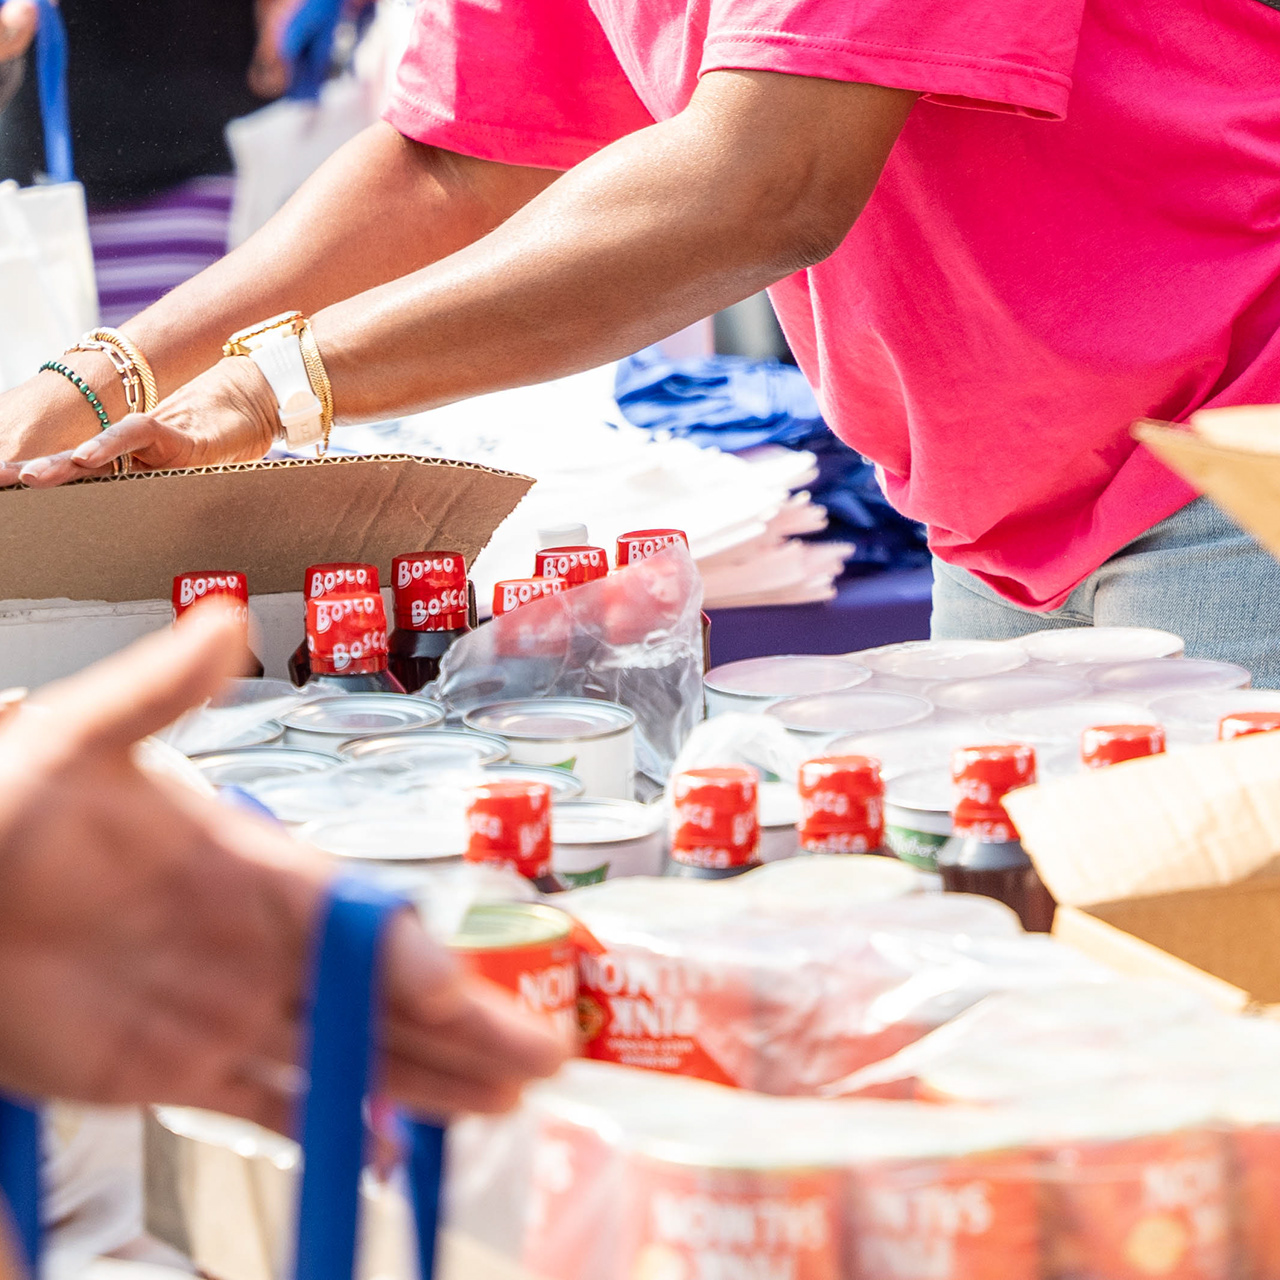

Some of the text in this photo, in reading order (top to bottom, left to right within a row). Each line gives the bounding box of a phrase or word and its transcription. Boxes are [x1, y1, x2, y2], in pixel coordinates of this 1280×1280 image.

[310, 569, 368, 599] BOSCO
[398, 557, 455, 589] BOSCO
[180, 575, 239, 606] BOSCO
[411, 588, 466, 627] BOSCO
[316, 597, 376, 634] BOSCO
[332, 631, 386, 671] BOSCO
